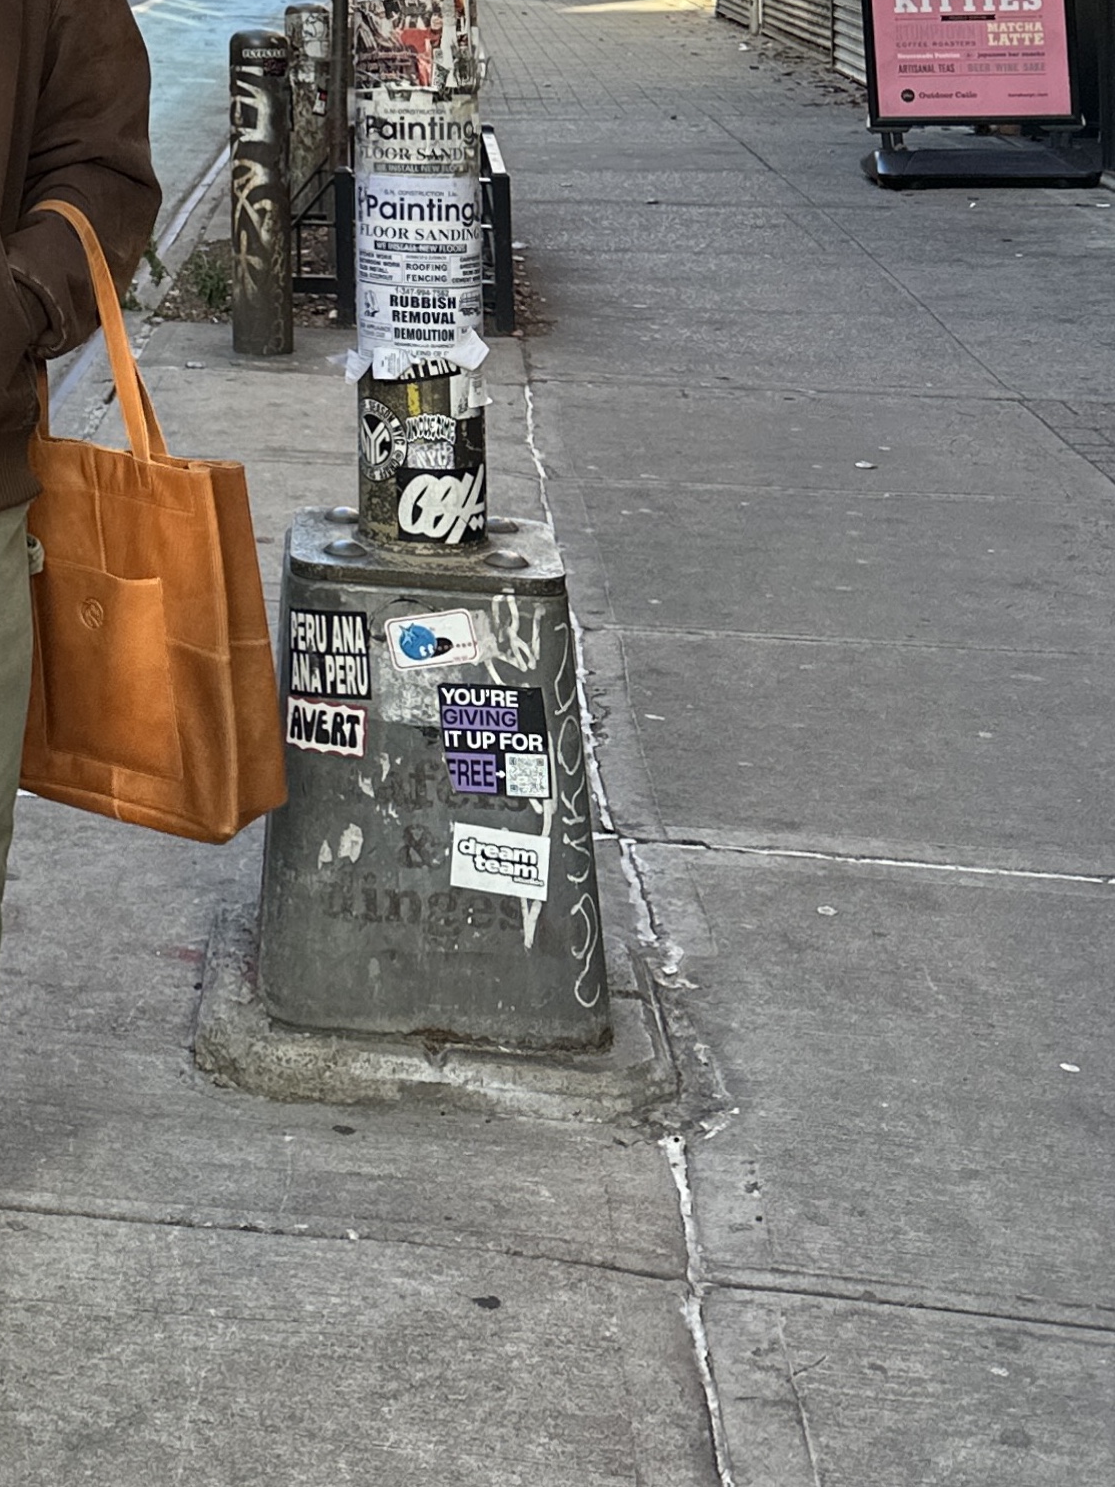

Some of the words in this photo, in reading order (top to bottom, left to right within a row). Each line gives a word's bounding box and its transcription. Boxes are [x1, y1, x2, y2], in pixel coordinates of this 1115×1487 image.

[987, 22, 1043, 33] MATCHA
[896, 41, 928, 49] COFFEE
[932, 40, 977, 48] ROASTERS
[987, 33, 1044, 46] LATTE
[898, 63, 935, 74] ARTISANAL
[938, 63, 956, 73] TEAS
[996, 63, 1019, 72] WINE
[918, 91, 954, 99] Outdoor
[366, 115, 477, 145] Painting
[388, 165, 420, 173] INSTALL
[421, 165, 440, 173] NEW
[366, 194, 476, 227] Painting
[360, 224, 410, 240] FLOOR
[415, 228, 481, 242] SANDING
[420, 244, 439, 253] NEW
[406, 263, 448, 272] ROOFING
[406, 274, 448, 282] FENCING
[390, 295, 457, 309] RUBBISH
[392, 310, 456, 325] REMOVAL
[394, 327, 455, 342] DEMOLITION
[361, 416, 391, 465] NYC
[290, 612, 327, 653] PERU
[332, 615, 366, 655] ANA
[325, 655, 368, 697] PERU
[441, 686, 519, 708] YOU'RE
[289, 704, 361, 748] AVERT
[442, 708, 517, 728] GIVING
[443, 730, 462, 748] IT
[466, 731, 496, 749] UP
[499, 733, 544, 752] FOR
[448, 758, 495, 788] FREE
[457, 837, 539, 866] dream
[473, 855, 540, 880] team
